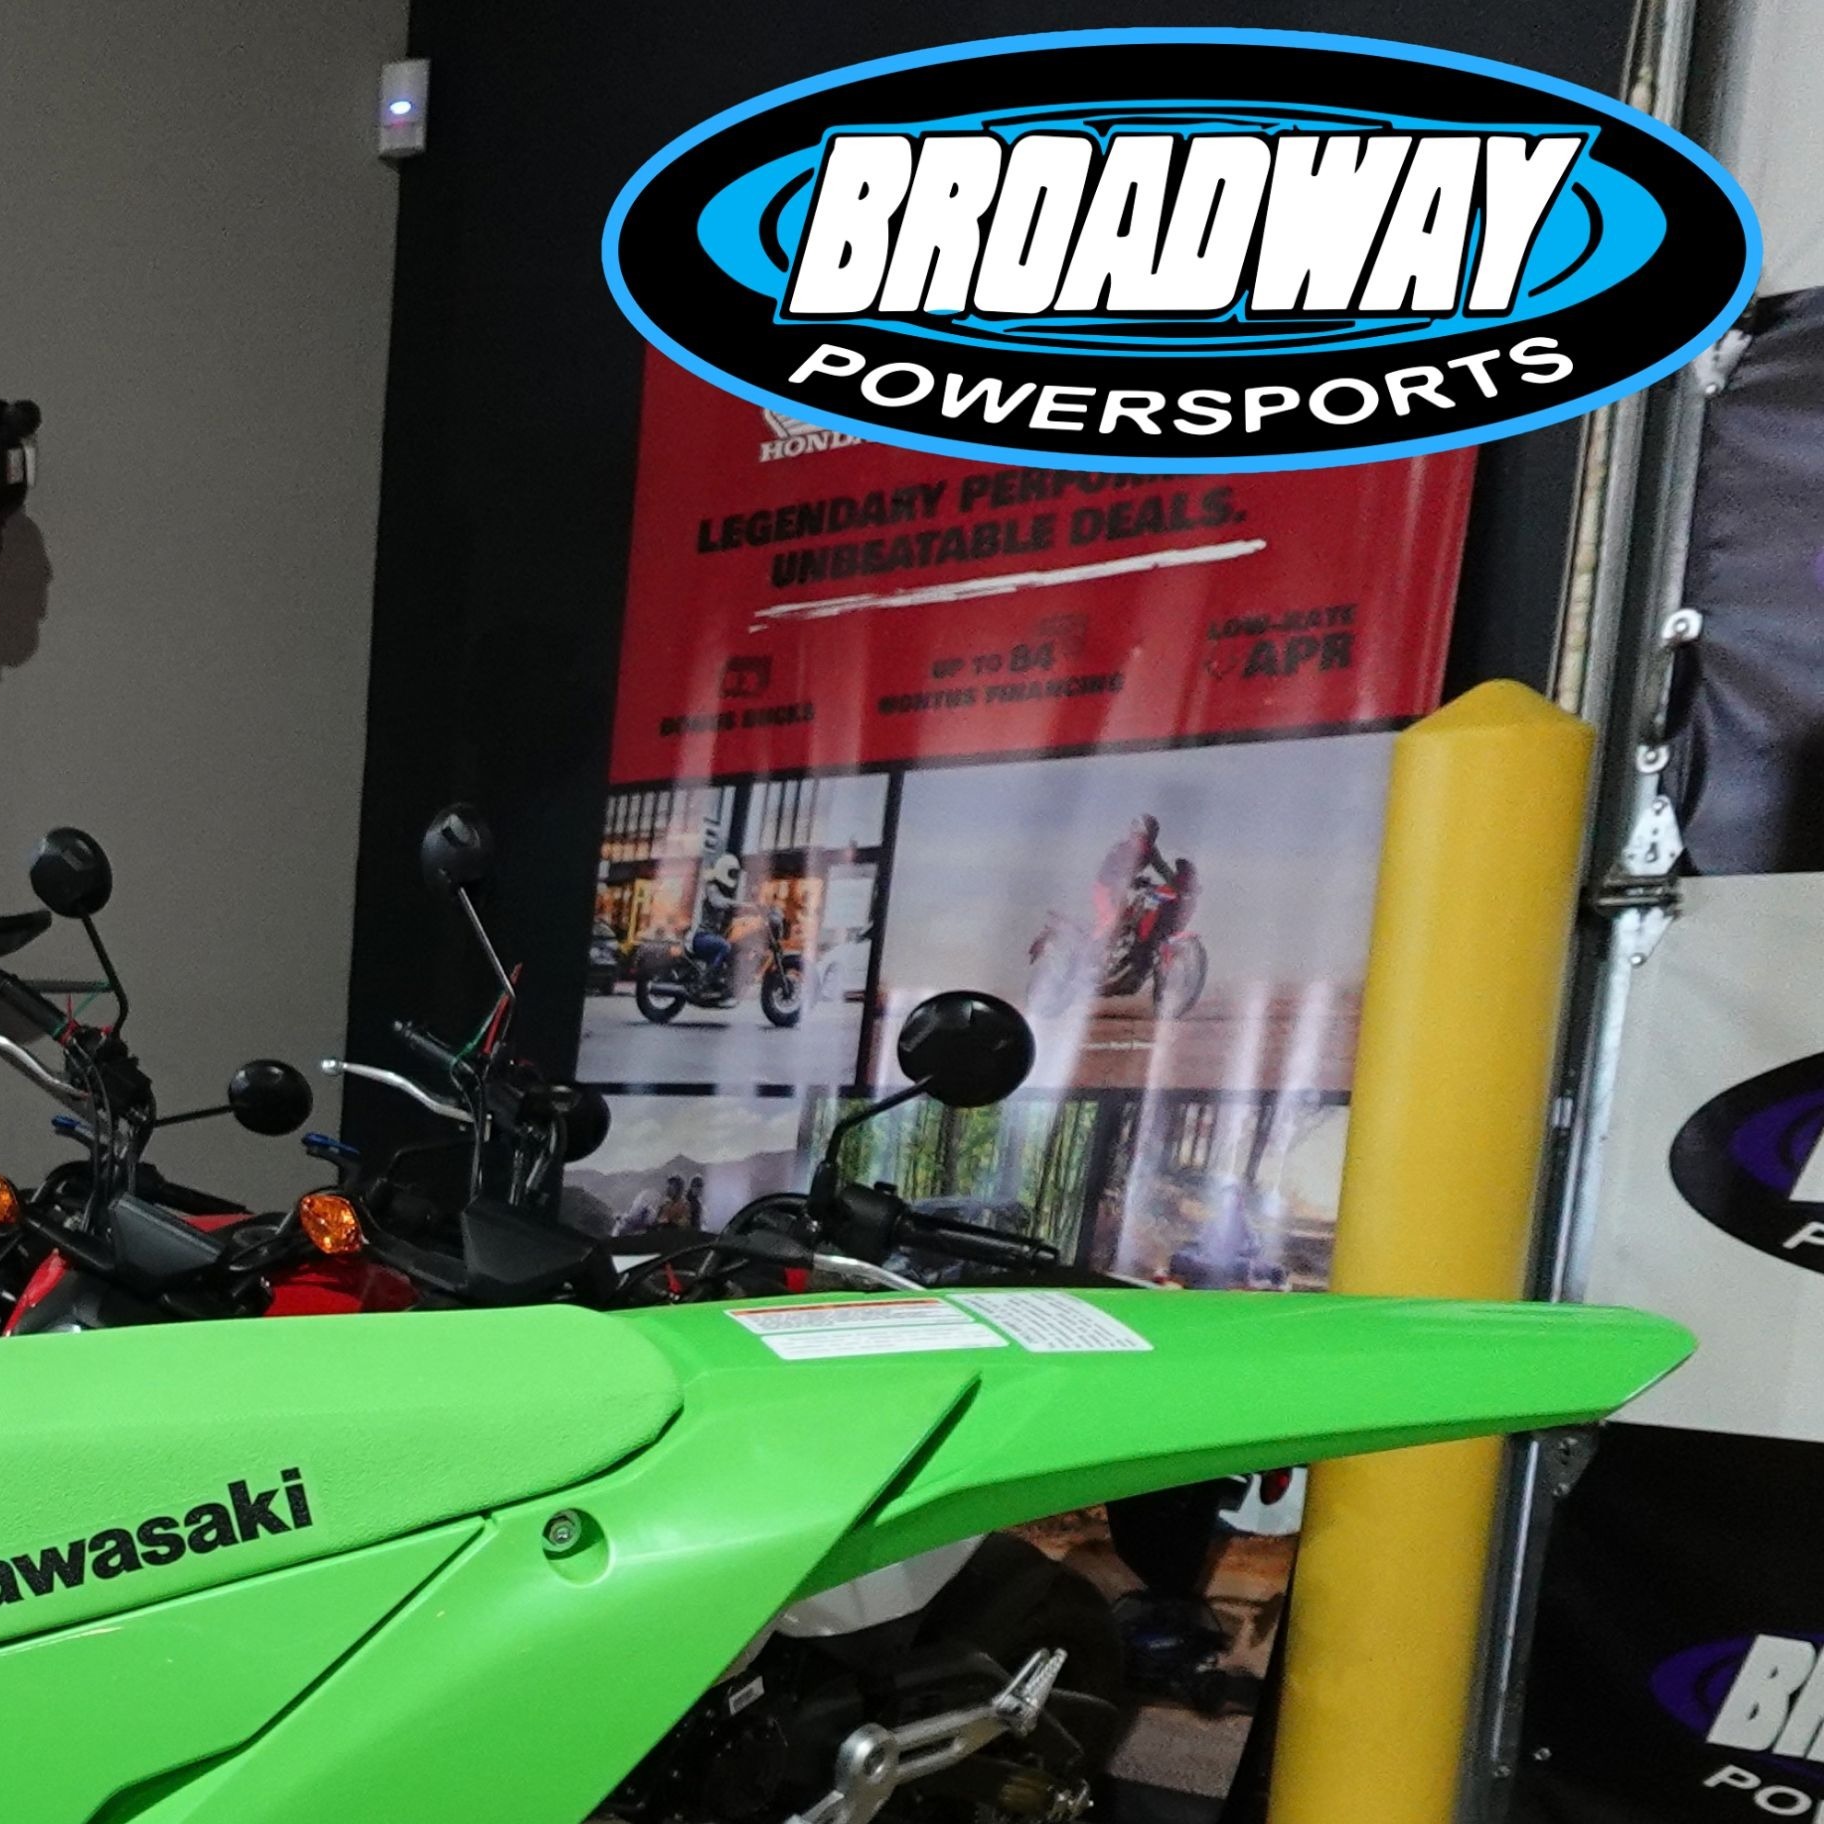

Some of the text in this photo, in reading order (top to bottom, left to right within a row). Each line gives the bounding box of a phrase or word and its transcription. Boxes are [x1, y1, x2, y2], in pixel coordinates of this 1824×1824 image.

[759, 431, 860, 462] HOND
[696, 480, 947, 553] LEGENDARY
[771, 487, 1247, 588] UNBEATABLE DEALS.
[1242, 631, 1355, 679] APR
